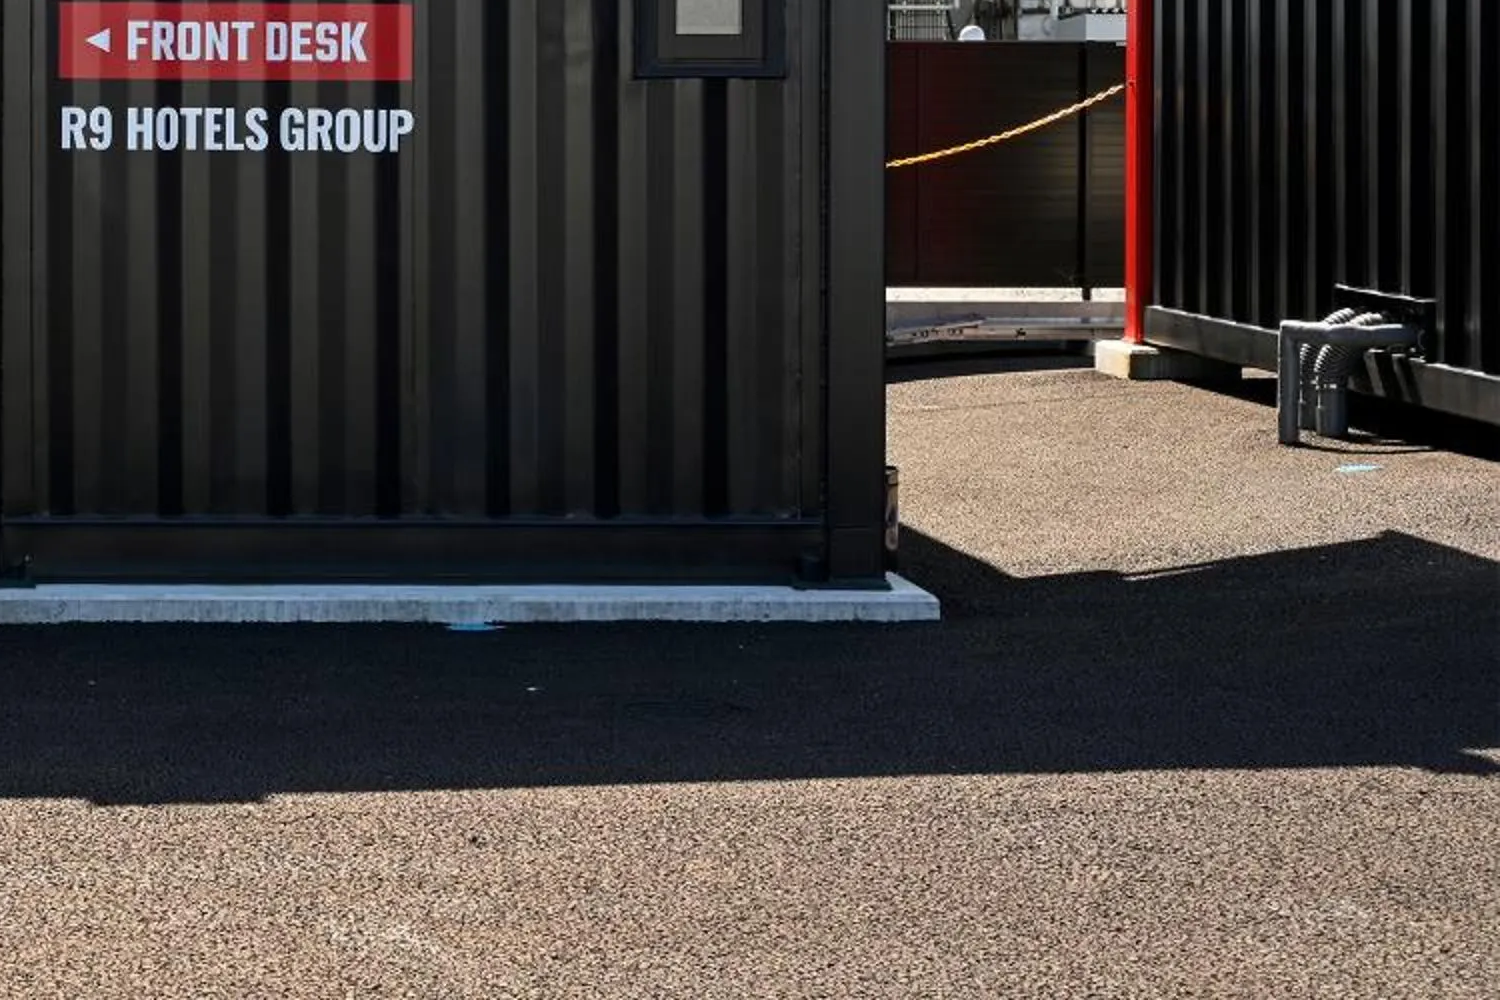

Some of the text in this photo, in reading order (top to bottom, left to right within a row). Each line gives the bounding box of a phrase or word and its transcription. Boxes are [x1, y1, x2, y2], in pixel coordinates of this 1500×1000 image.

[128, 21, 368, 62] FRONT DESK
[62, 107, 414, 152] R9 HOTELS GROUP
